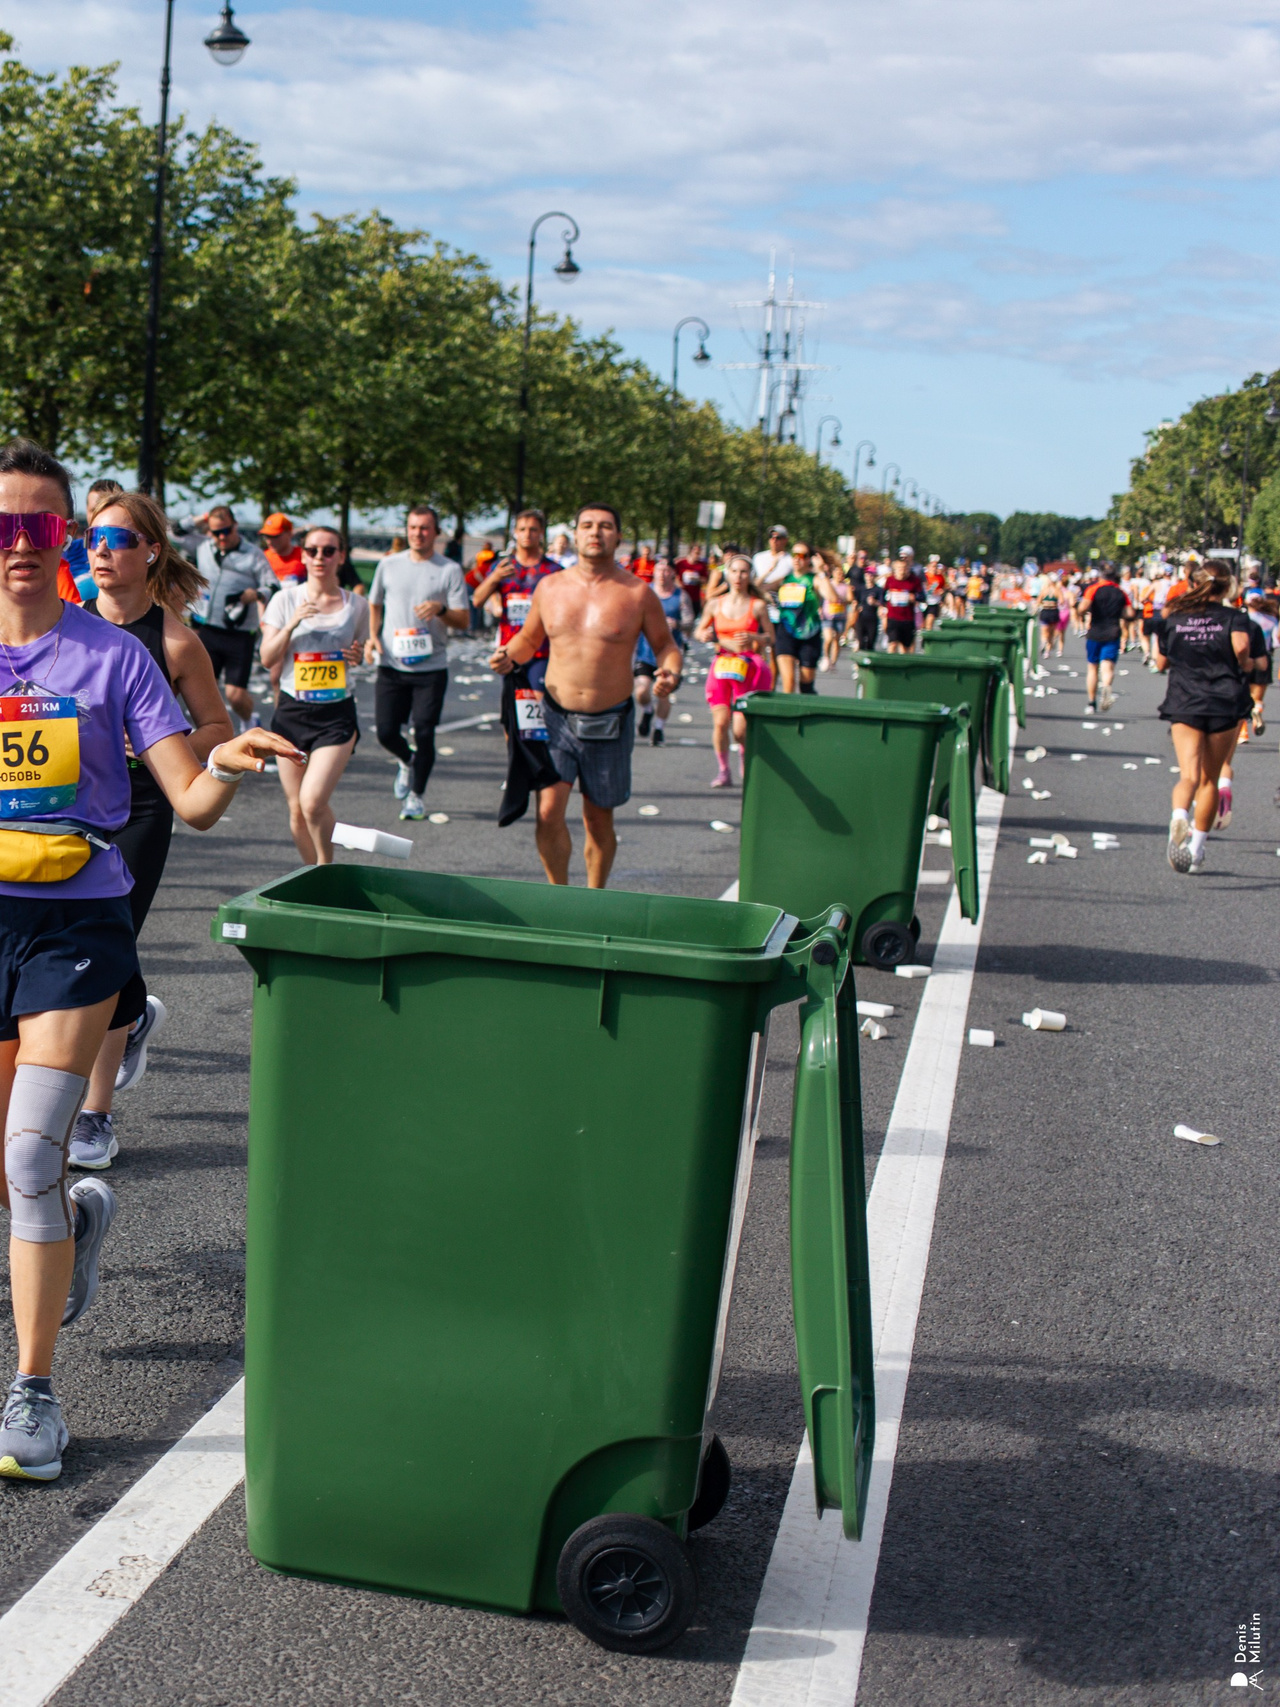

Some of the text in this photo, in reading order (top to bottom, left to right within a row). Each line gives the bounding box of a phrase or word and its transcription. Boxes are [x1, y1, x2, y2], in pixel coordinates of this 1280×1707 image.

[299, 665, 338, 681] 2778
[20, 702, 39, 713] 21,1
[525, 704, 543, 719] 22
